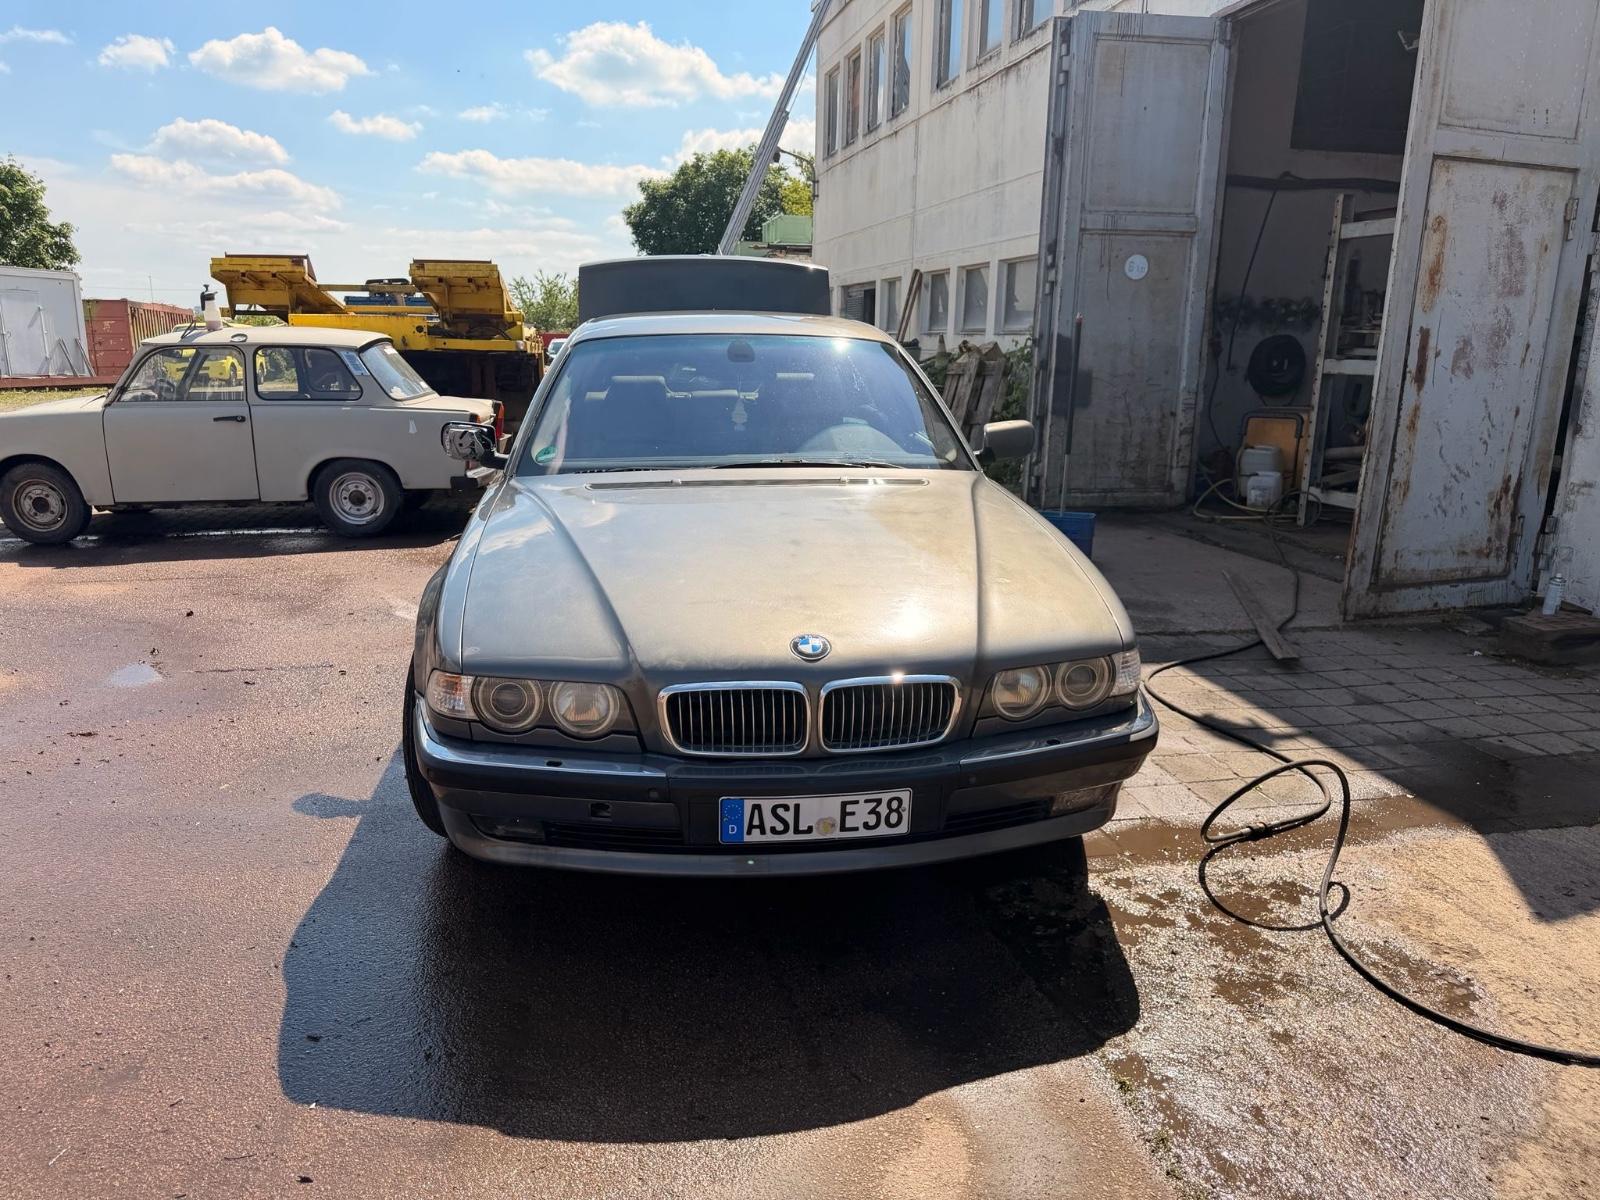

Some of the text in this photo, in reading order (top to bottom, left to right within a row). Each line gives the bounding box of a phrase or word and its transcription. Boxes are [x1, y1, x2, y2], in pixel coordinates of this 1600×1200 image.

[746, 797, 903, 835] ASL E38
[729, 825, 737, 834] D
